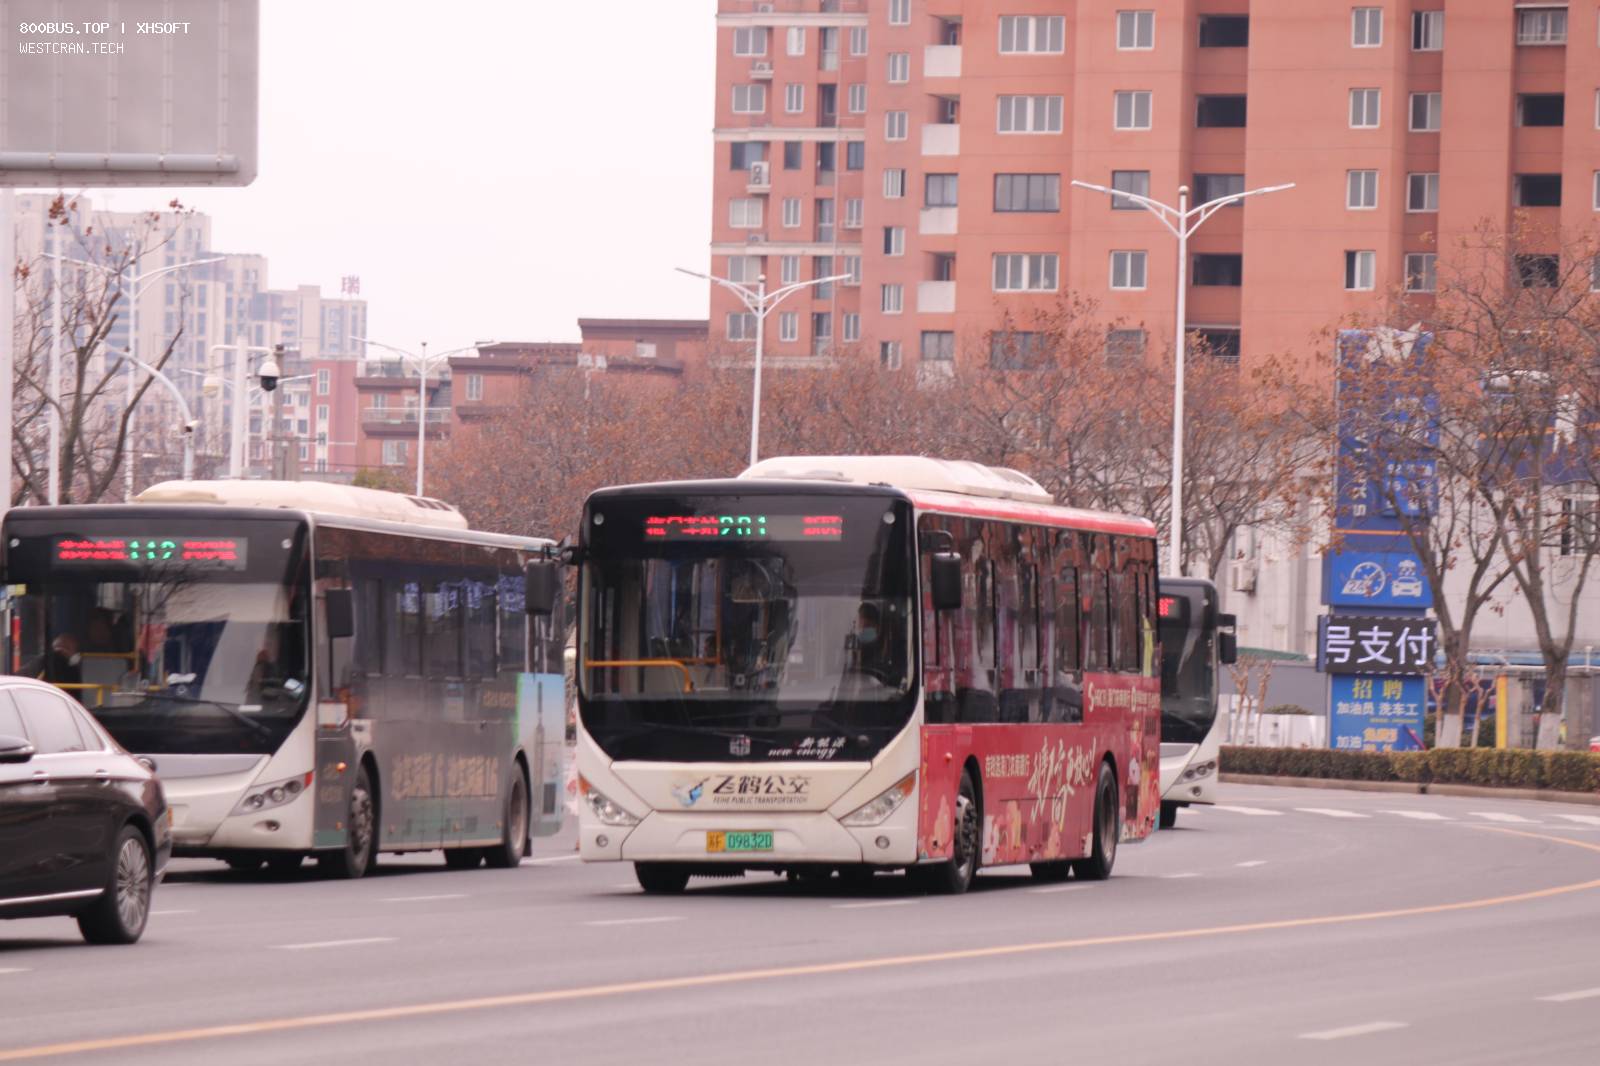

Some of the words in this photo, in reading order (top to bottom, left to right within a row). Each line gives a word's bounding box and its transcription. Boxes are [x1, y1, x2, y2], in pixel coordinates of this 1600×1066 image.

[1326, 625, 1433, 665] 号支付
[1336, 701, 1375, 715] 加油员
[1378, 701, 1419, 716] 洗车工
[799, 736, 847, 748] 新能源
[713, 774, 812, 794] 飞鹤公交
